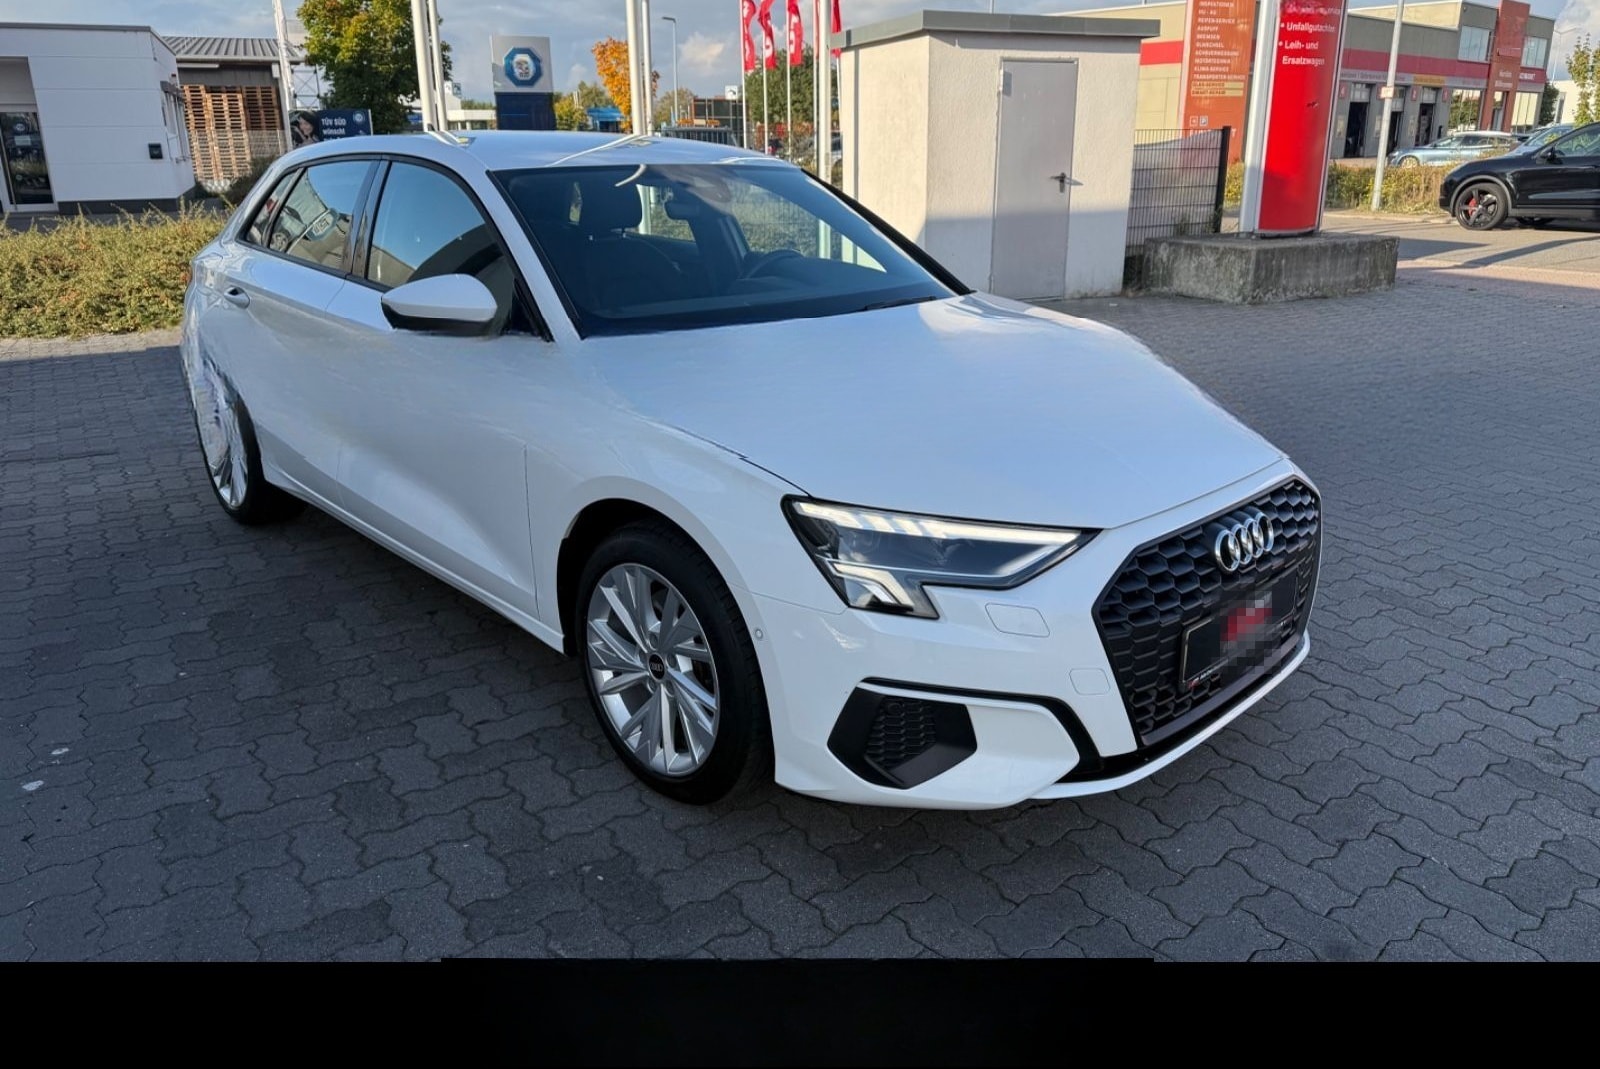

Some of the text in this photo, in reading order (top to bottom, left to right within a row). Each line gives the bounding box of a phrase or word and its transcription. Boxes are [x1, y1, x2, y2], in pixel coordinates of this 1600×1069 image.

[1284, 40, 1319, 49] Leih- und
[1282, 56, 1325, 67] Ersatzwagen
[321, 117, 347, 126] TÜV SÜD
